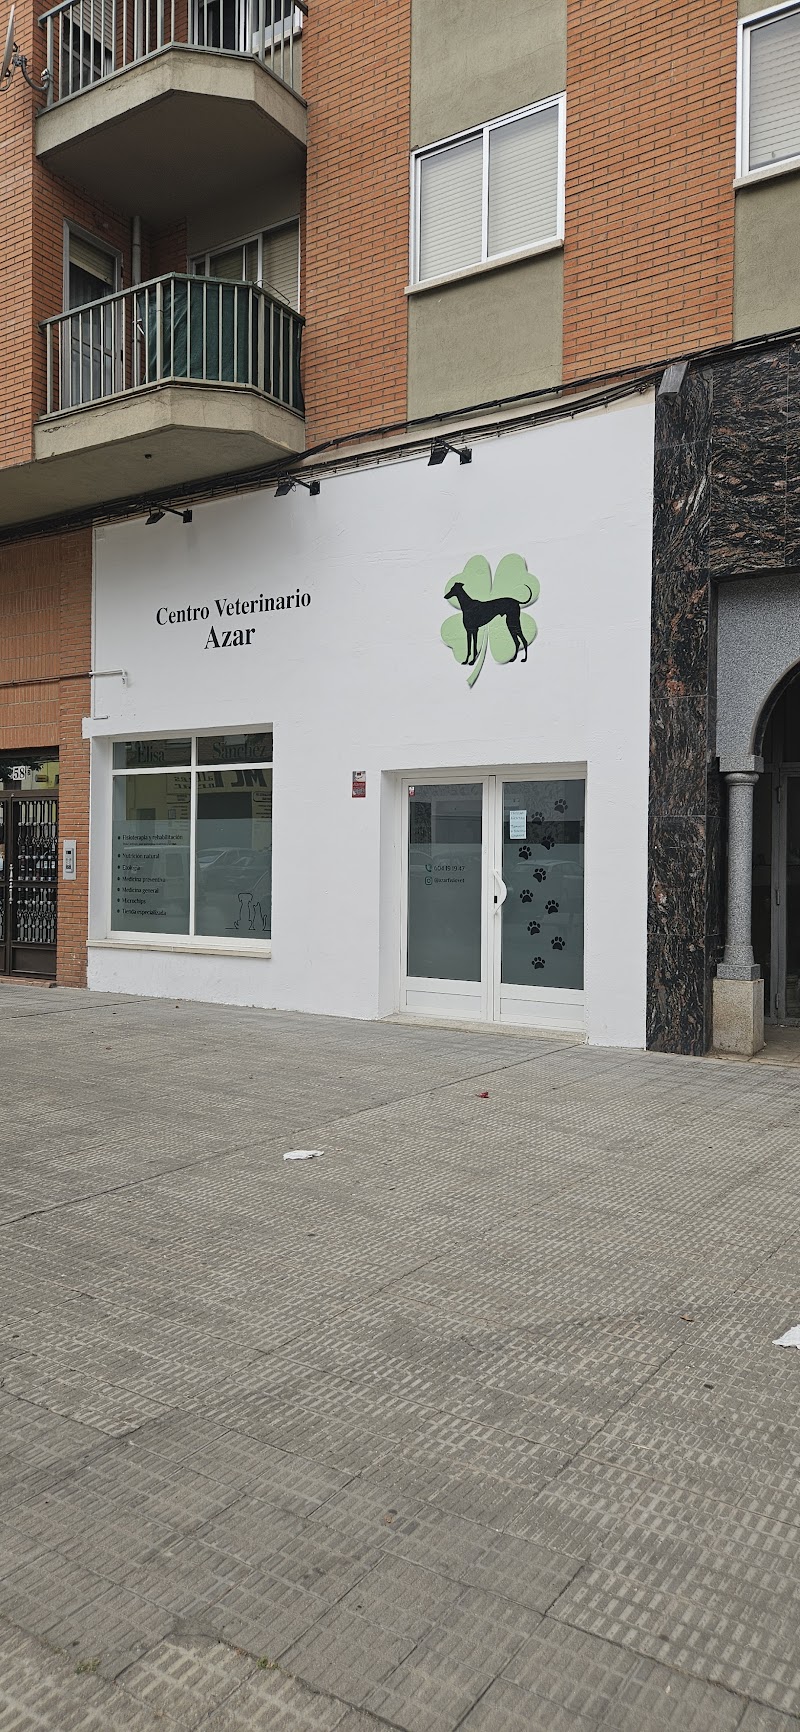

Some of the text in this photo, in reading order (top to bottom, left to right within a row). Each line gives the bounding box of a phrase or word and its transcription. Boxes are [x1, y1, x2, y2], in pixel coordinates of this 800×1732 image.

[156, 588, 312, 626] Centro Veterinario
[204, 625, 256, 650] Azar
[136, 741, 267, 763] Elisa Sánchez
[12, 767, 25, 779] 58
[122, 834, 147, 842] Fisioterapia
[122, 897, 147, 905] Microchips
